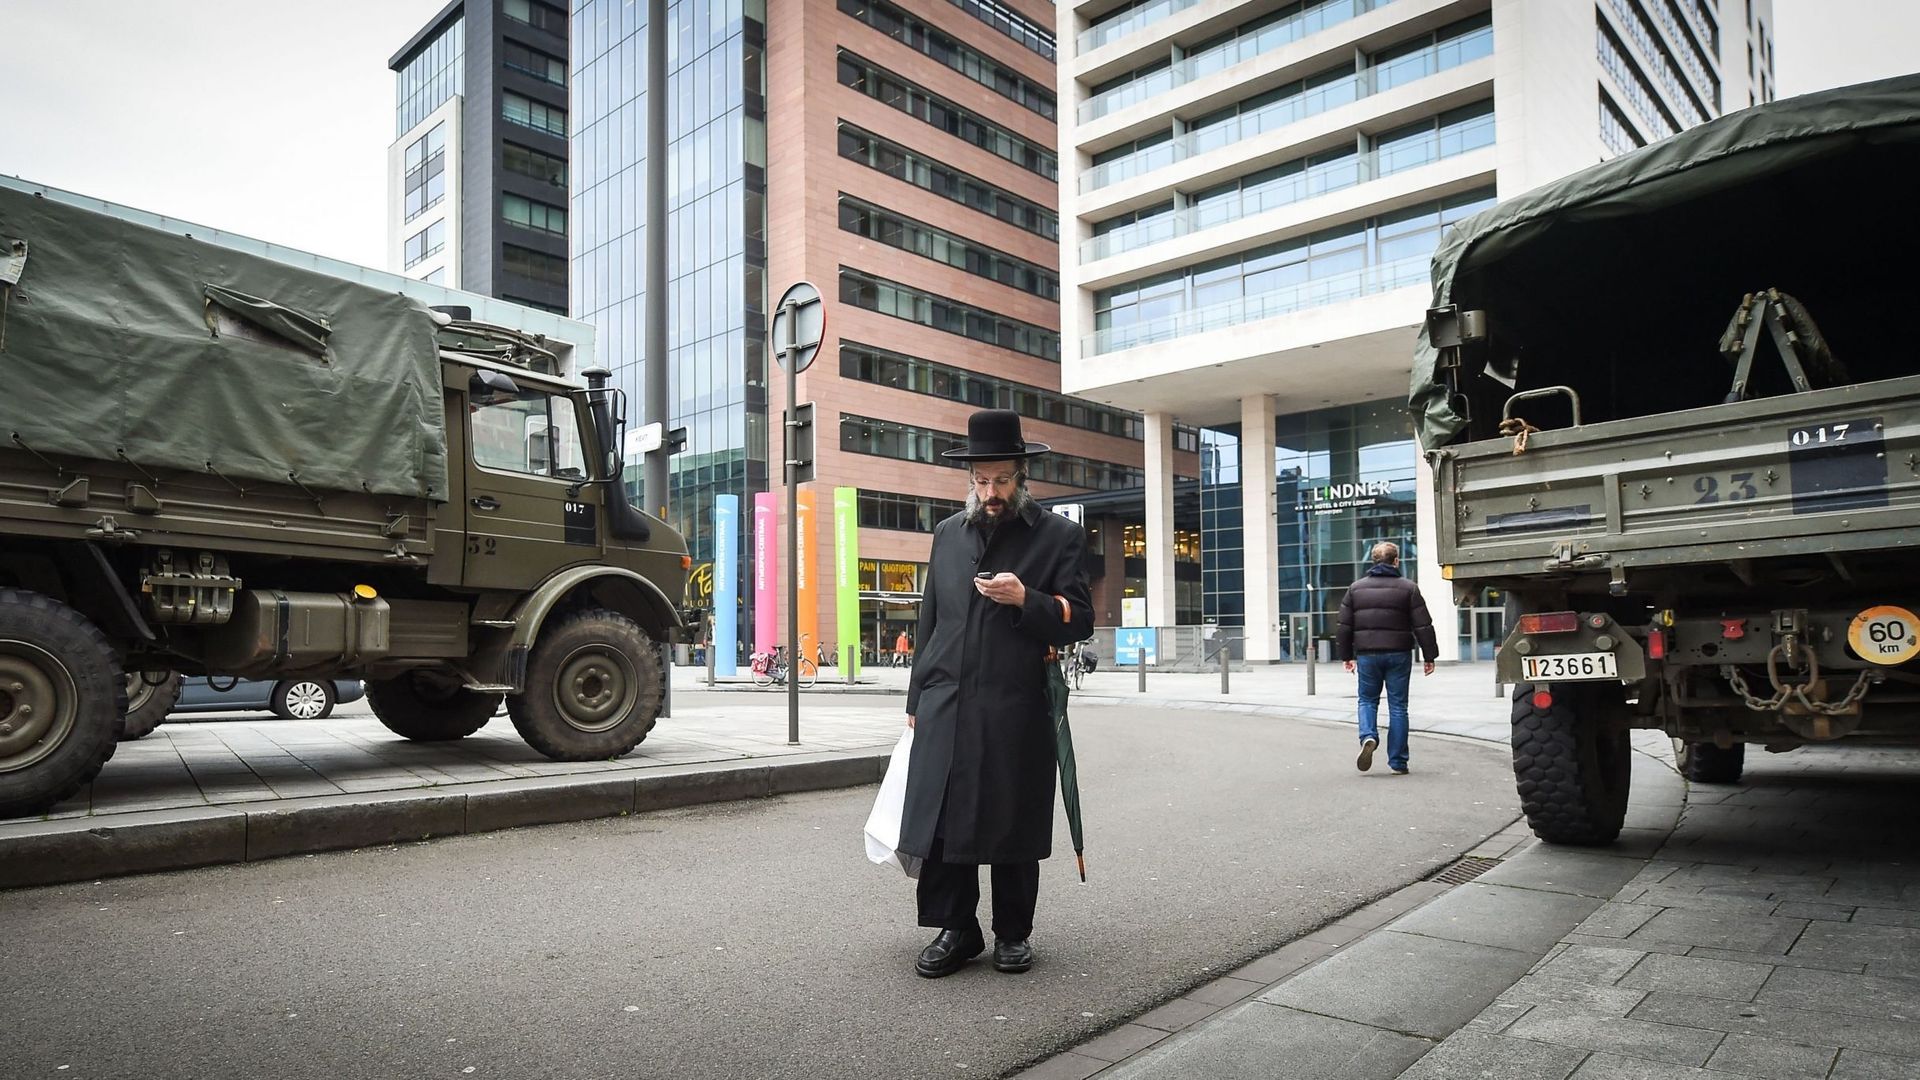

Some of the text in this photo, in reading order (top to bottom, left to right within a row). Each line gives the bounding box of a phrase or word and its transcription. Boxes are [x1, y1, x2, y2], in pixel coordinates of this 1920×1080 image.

[1792, 423, 1850, 446] 017
[1693, 472, 1758, 504] 23
[565, 502, 585, 514] 017
[1314, 502, 1333, 510] HOTEL
[1339, 500, 1352, 508] CITY
[860, 561, 876, 571] PAIN
[1869, 621, 1905, 643] 60
[1878, 643, 1900, 653] km
[1539, 656, 1607, 677] 23661
